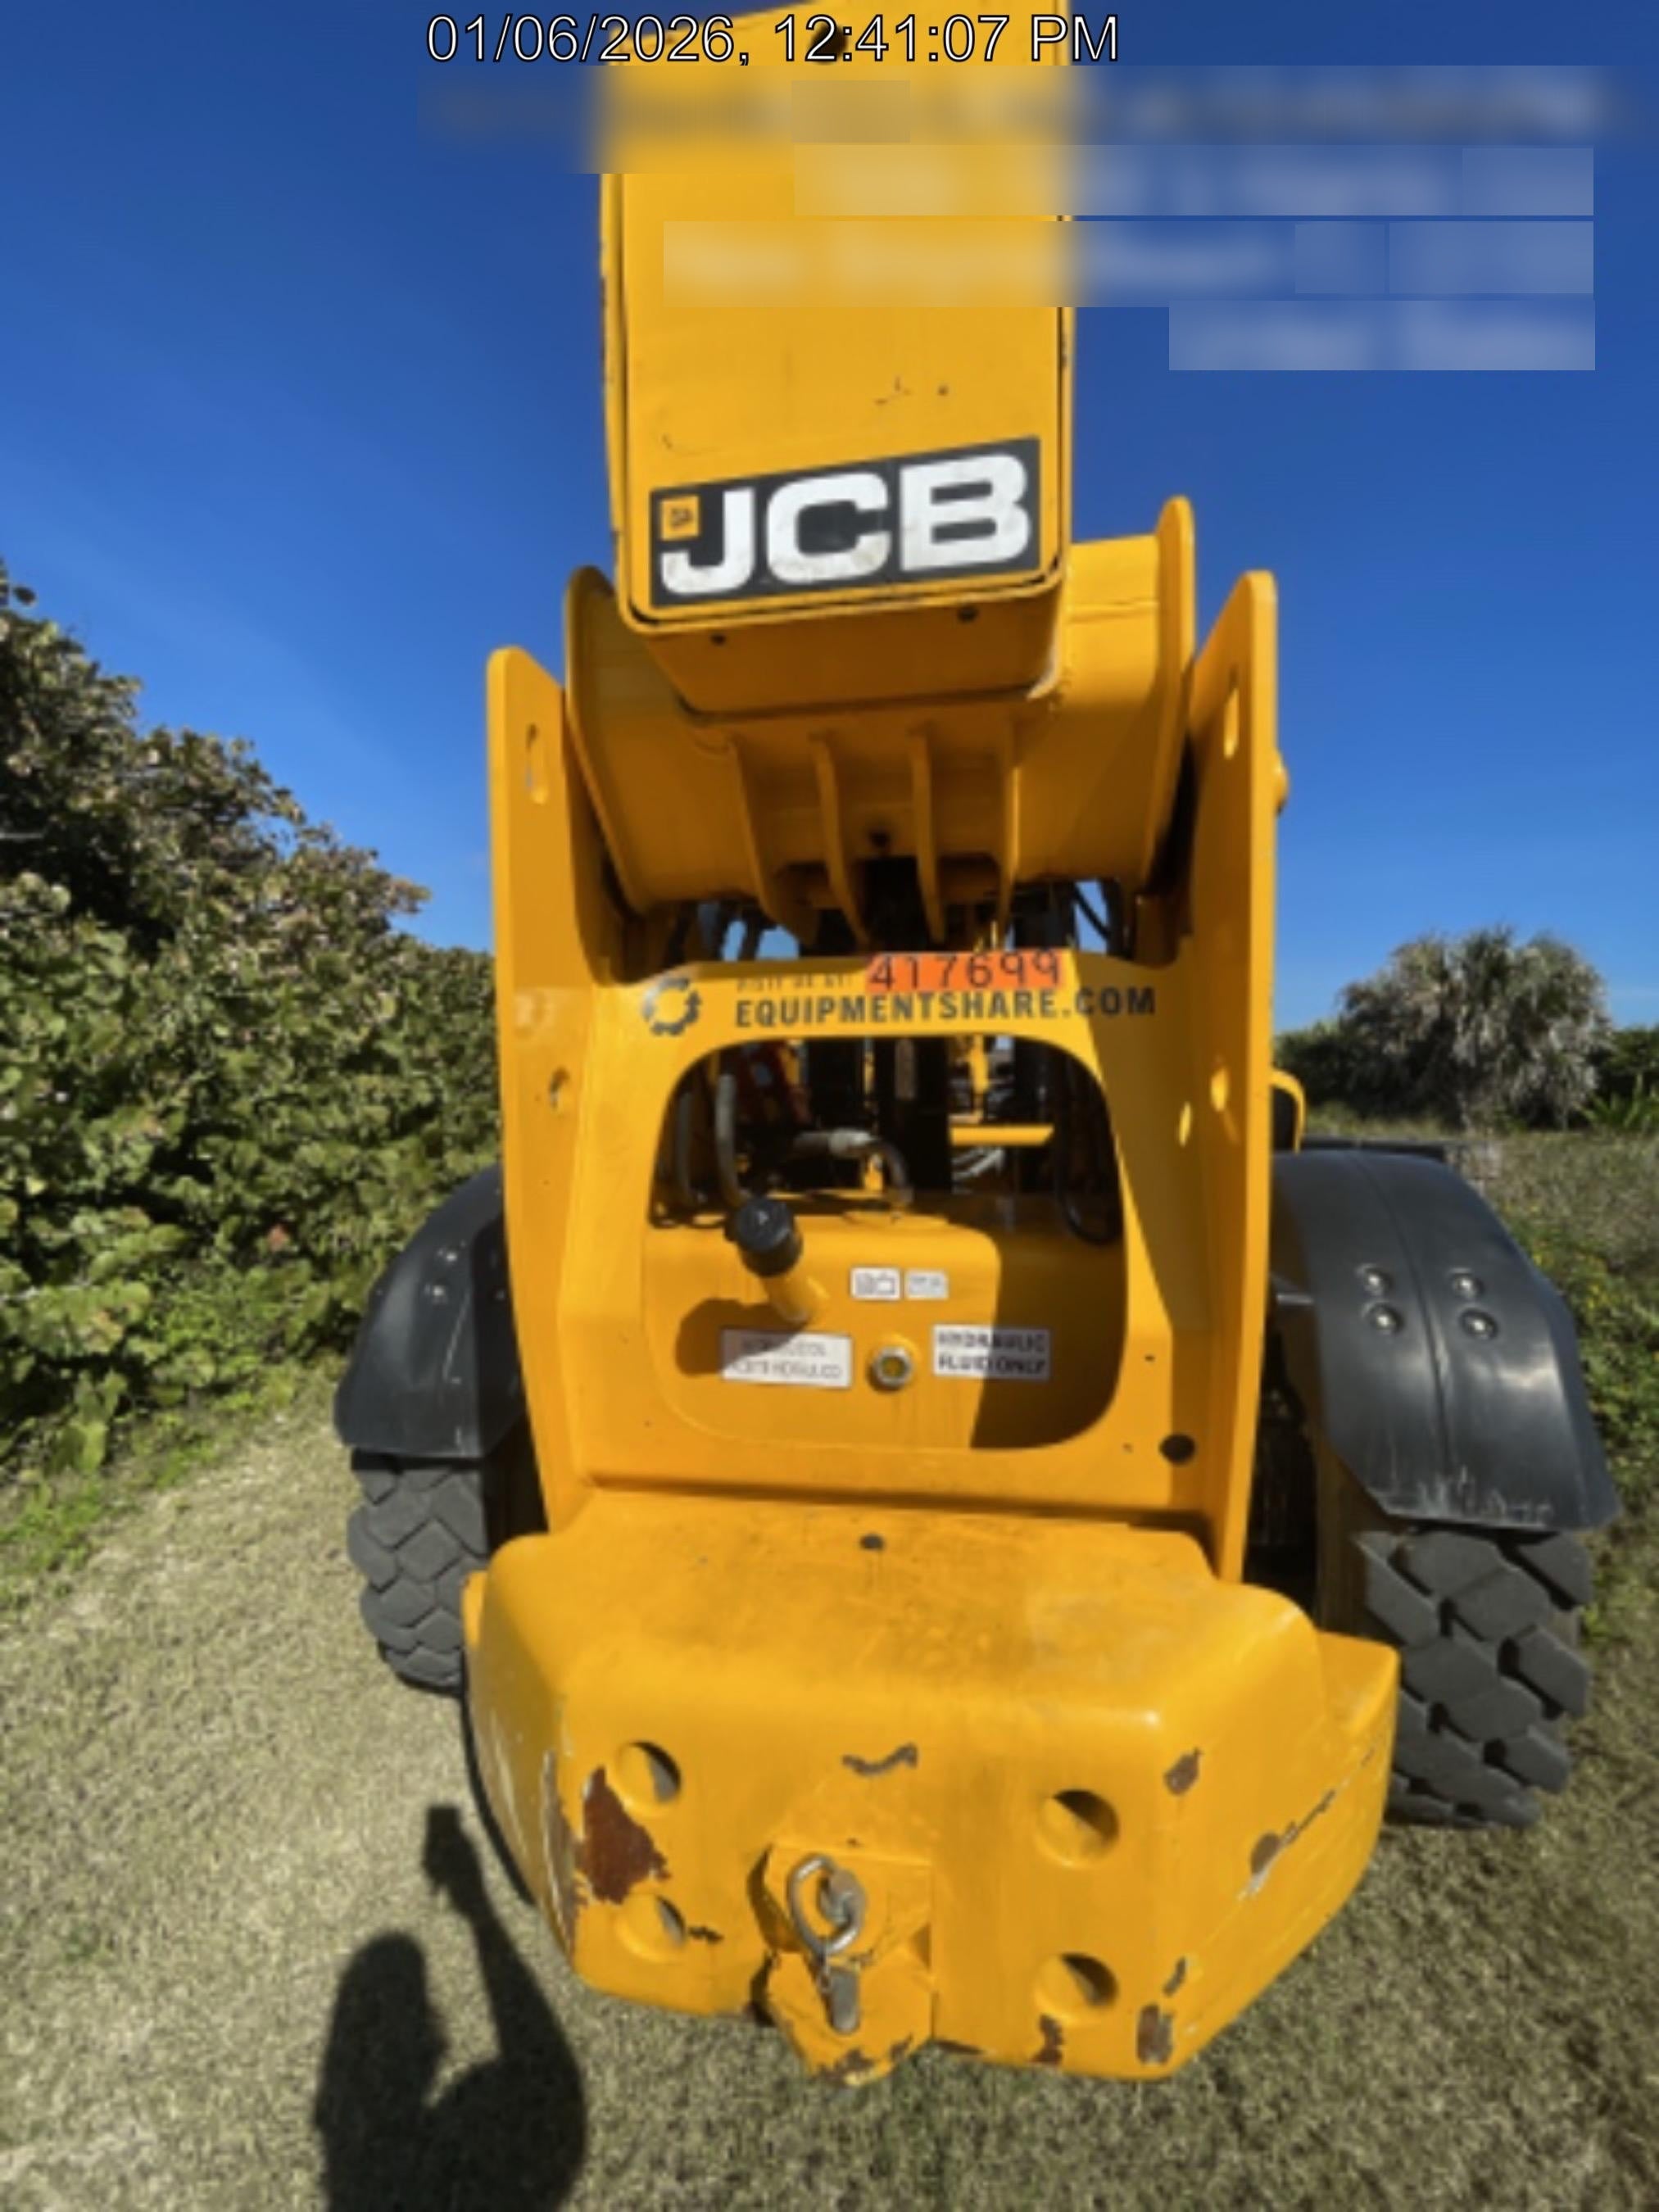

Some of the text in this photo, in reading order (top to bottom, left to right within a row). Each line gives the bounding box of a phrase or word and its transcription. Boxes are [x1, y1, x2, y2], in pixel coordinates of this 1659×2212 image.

[660, 453, 1031, 596] JCB
[868, 949, 1060, 990] 417699
[735, 985, 1156, 1028] EQUIPMENTSHARE.COM
